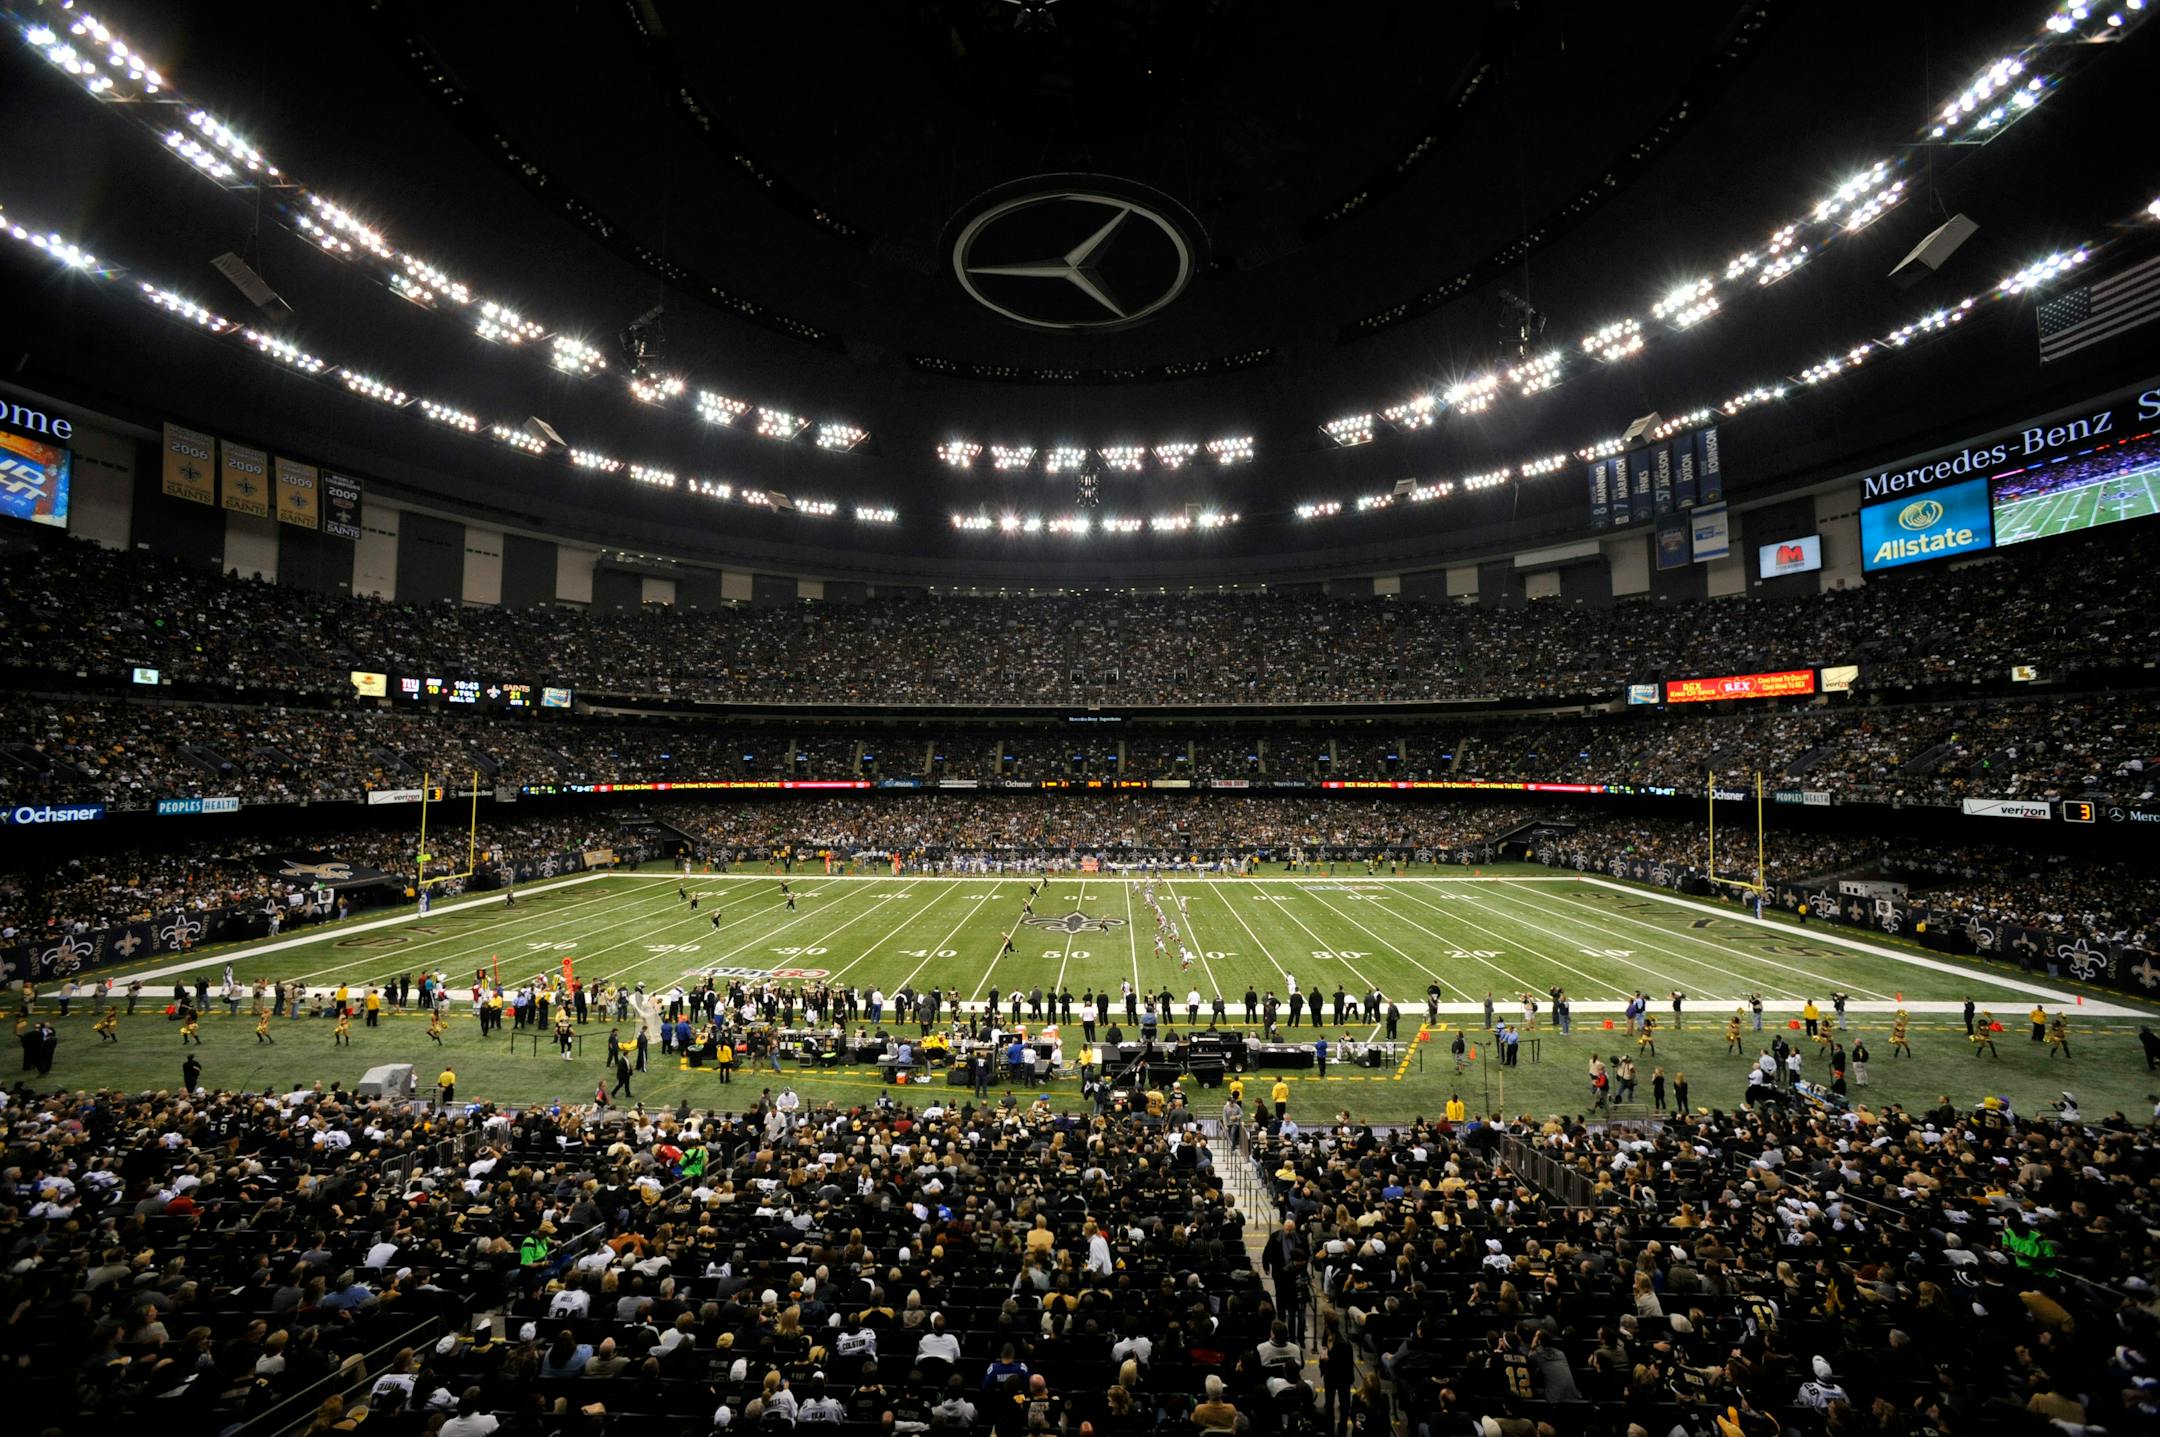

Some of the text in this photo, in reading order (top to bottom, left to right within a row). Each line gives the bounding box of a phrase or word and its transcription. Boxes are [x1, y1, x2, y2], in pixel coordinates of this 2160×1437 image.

[171, 441, 209, 460] 2006
[1706, 430, 1719, 474] ROBINSON
[1864, 411, 2112, 500] Mercedes-Benz
[228, 458, 262, 475] 2009
[1658, 449, 1670, 487] JACKSON
[1682, 453, 1693, 481] DIXON
[282, 474, 313, 489] 2009
[1595, 465, 1607, 504] MANNING
[1615, 458, 1628, 499] MARAVICH
[1639, 470, 1650, 494] FINKS
[167, 484, 211, 504] SAINTS
[328, 487, 358, 501] 2009
[225, 499, 267, 516] SAINTS
[1593, 507, 1607, 515] 8
[280, 512, 316, 528] SAINTS
[327, 524, 361, 539] SAINTS
[1873, 526, 1975, 564] Allstate
[427, 686, 439, 694] 10
[454, 681, 479, 690] 10:43
[503, 684, 530, 693] SAINTS
[1683, 683, 1701, 691] REX
[1725, 682, 1750, 692] REX
[1005, 780, 1032, 788] Ochsner
[394, 792, 421, 801] verizon
[434, 789, 440, 800] 3
[1711, 789, 1745, 801] Ochsner
[1776, 793, 1802, 802] PEOPLES
[159, 799, 239, 814] PEOPLES HEALTH
[2001, 805, 2046, 818] verizon
[2081, 804, 2090, 820] 3
[15, 806, 97, 824] Ochsner
[92, 933, 105, 962] SAINTS
[649, 944, 701, 952] 20
[779, 947, 827, 955] 30
[909, 949, 957, 957] 40
[1042, 950, 1090, 959] 50
[1312, 951, 1361, 959] 30
[1444, 950, 1496, 958] 20
[1580, 949, 1632, 957] 10
[29, 947, 40, 976] SAINTS
[1752, 1304, 1778, 1332] 17
[377, 1381, 401, 1392] GRAHAM
[1505, 1366, 1535, 1398] 12
[1804, 1381, 1820, 1396] 28
